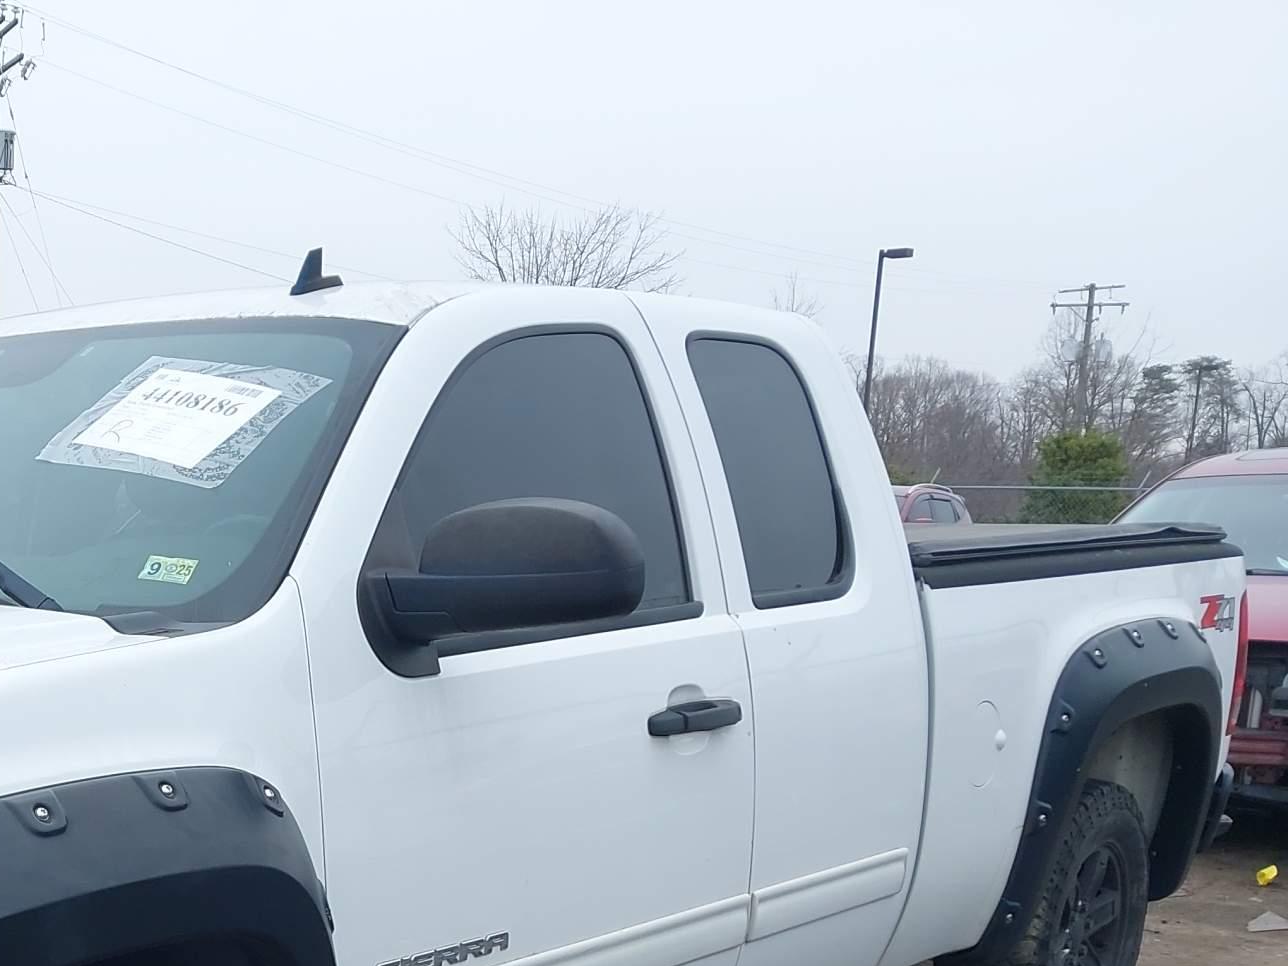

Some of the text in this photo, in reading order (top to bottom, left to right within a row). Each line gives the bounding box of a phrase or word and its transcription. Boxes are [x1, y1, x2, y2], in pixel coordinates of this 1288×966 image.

[143, 387, 247, 416] 44108186
[147, 562, 193, 577] 9 25
